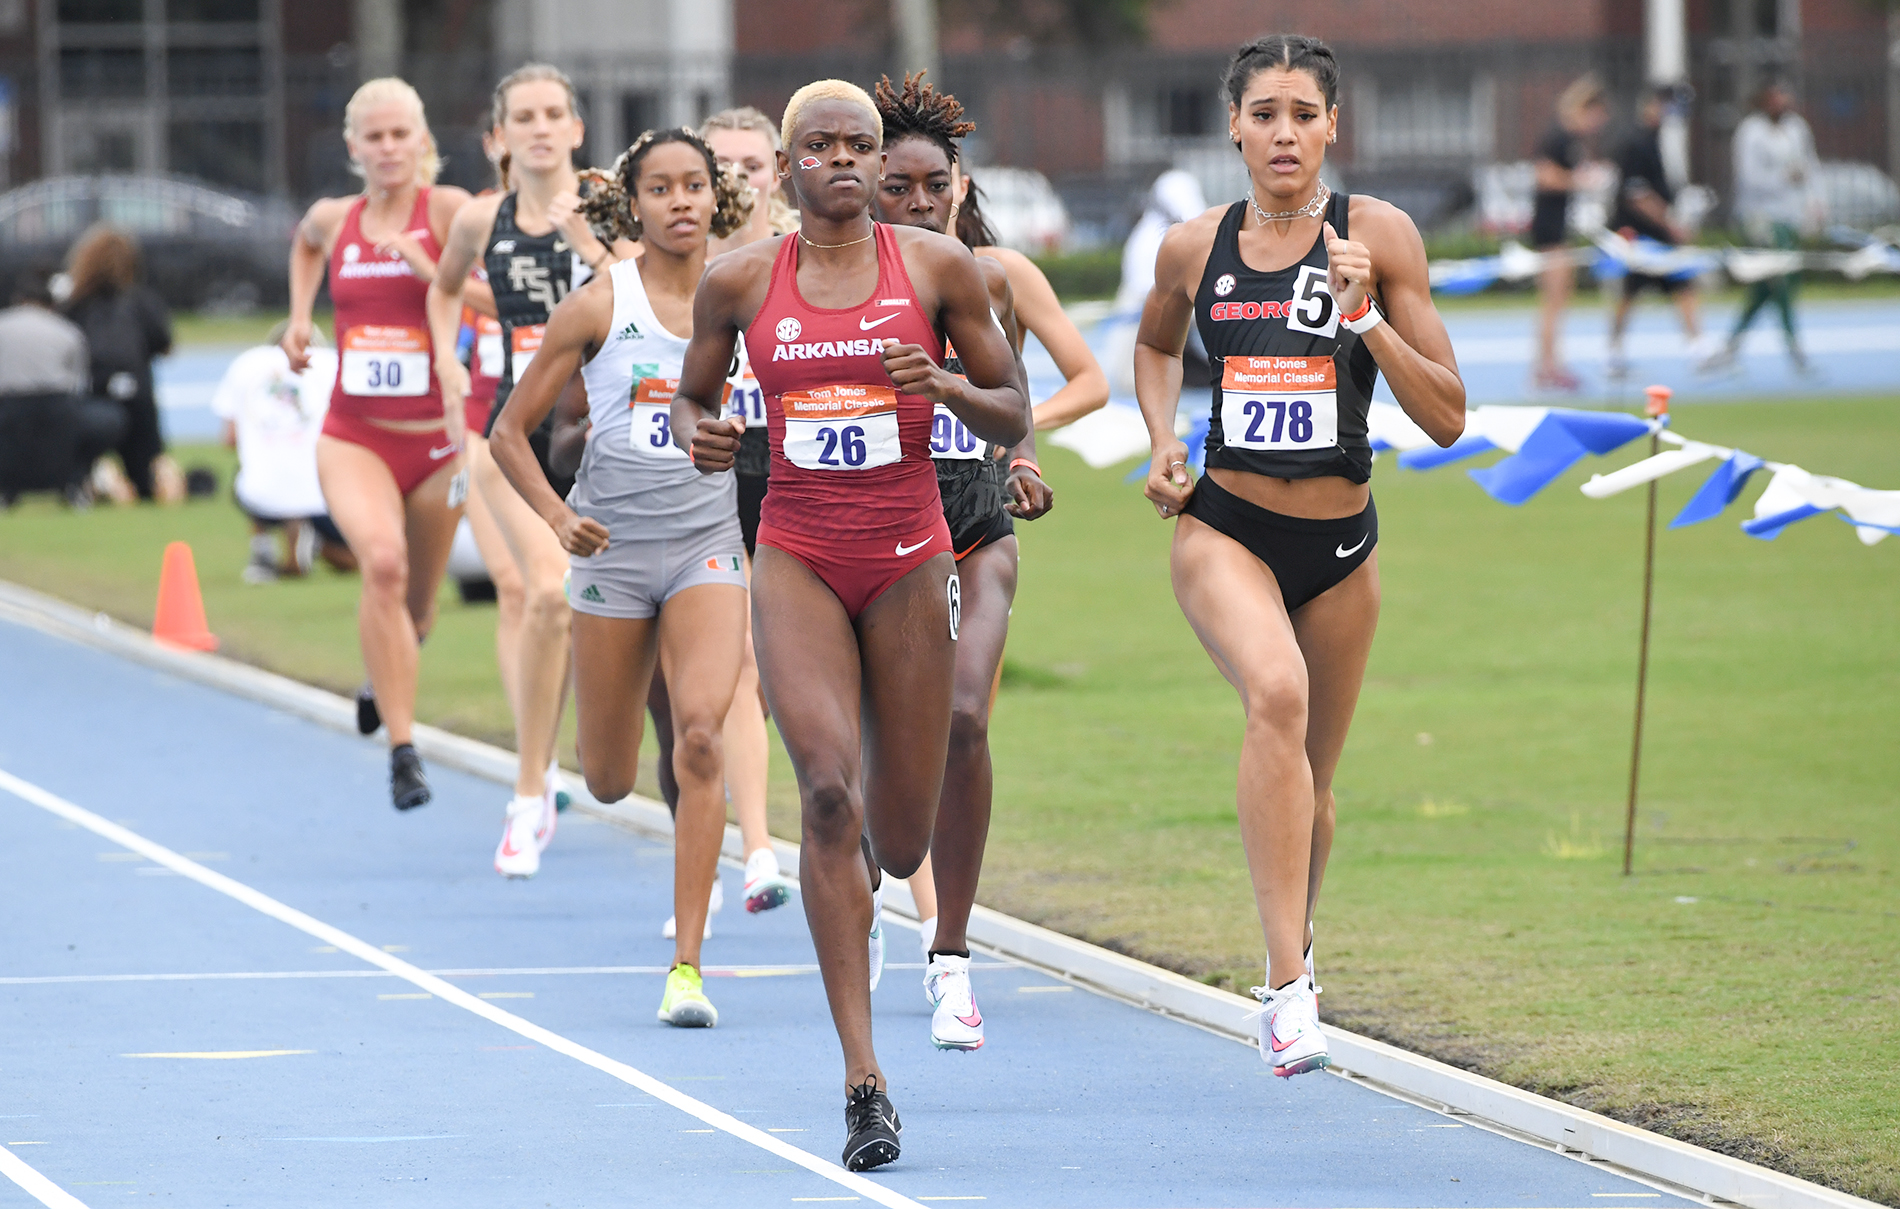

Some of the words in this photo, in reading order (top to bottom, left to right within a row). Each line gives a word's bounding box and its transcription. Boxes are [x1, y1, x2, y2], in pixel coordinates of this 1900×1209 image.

[1296, 272, 1333, 328] 5
[778, 319, 800, 340] SEC
[368, 361, 401, 387] 30
[1248, 358, 1271, 369] Tom
[1273, 359, 1308, 369] Jones
[1234, 372, 1280, 383] Memorial
[1283, 372, 1325, 383] Classic
[807, 390, 832, 400] Tom
[834, 386, 866, 397] Jones
[794, 401, 842, 411] Memorial
[1243, 400, 1313, 443] 278
[816, 425, 866, 466] 26
[950, 579, 958, 636] 6
